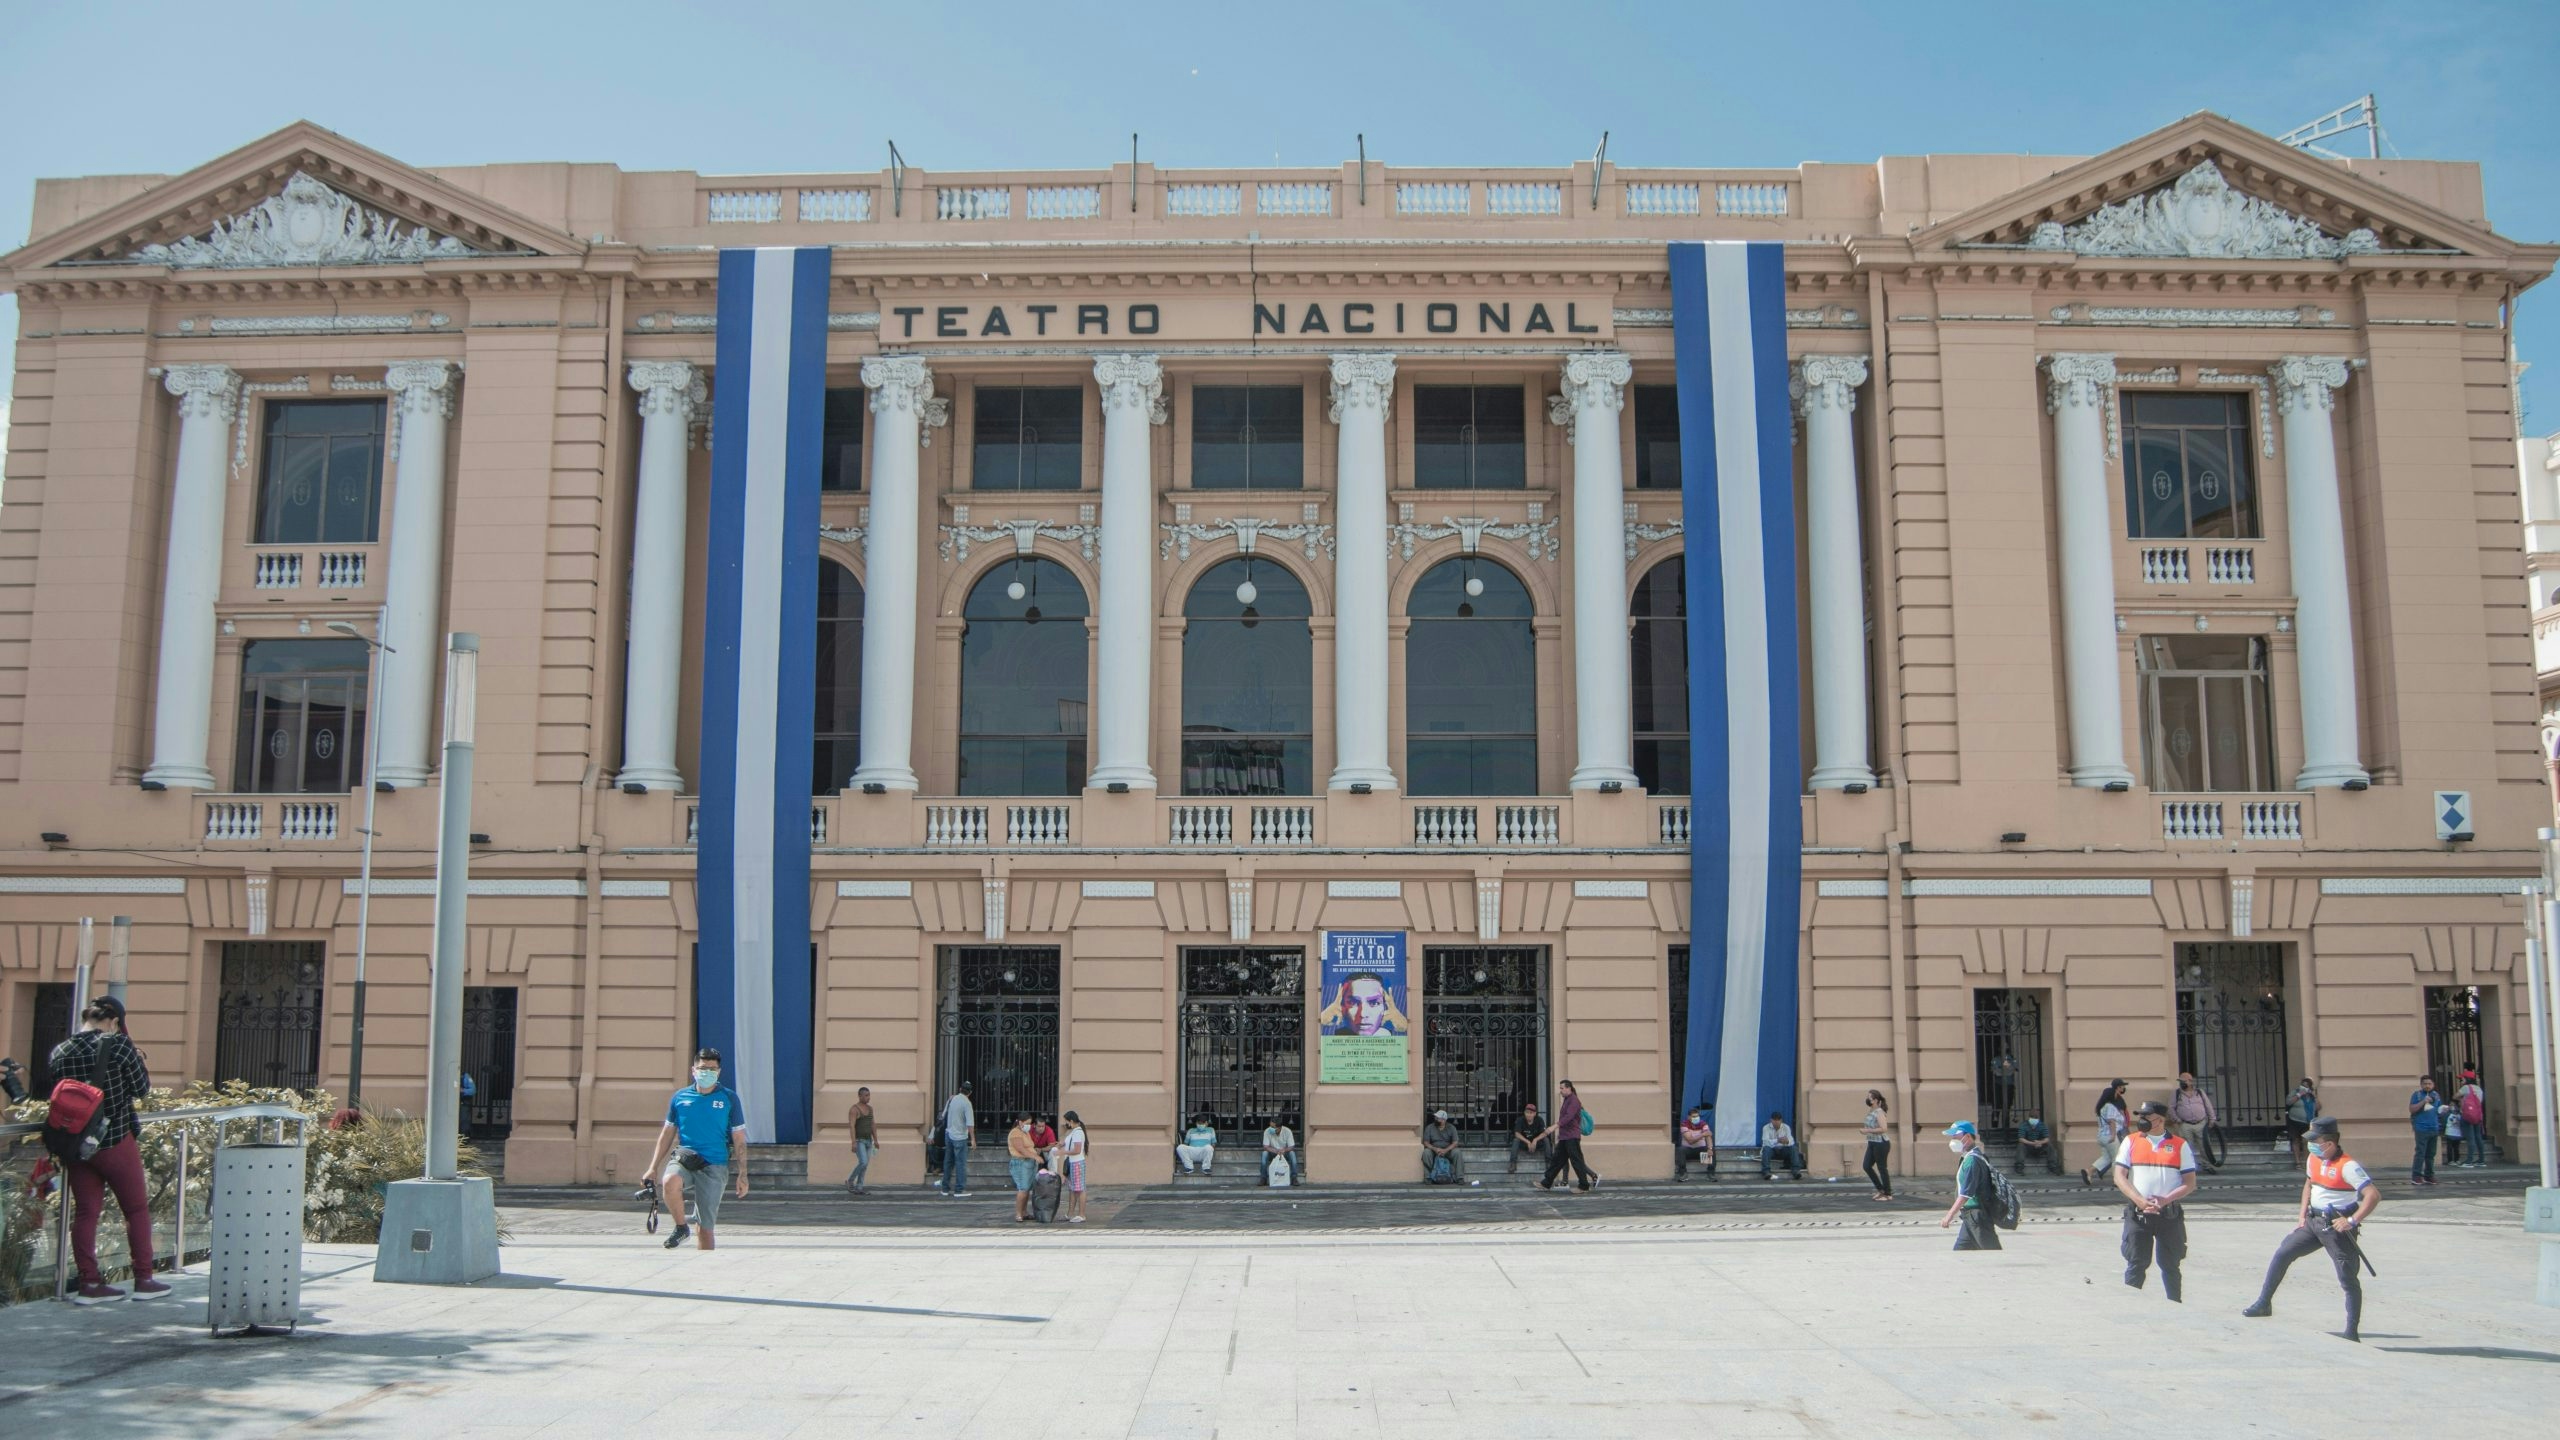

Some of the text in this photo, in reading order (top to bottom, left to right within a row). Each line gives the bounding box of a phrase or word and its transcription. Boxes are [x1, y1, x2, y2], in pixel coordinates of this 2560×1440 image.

[893, 301, 1599, 338] TEATRO NACIONAL
[1338, 945, 1394, 959] TEATRO
[712, 1100, 724, 1108] ES
